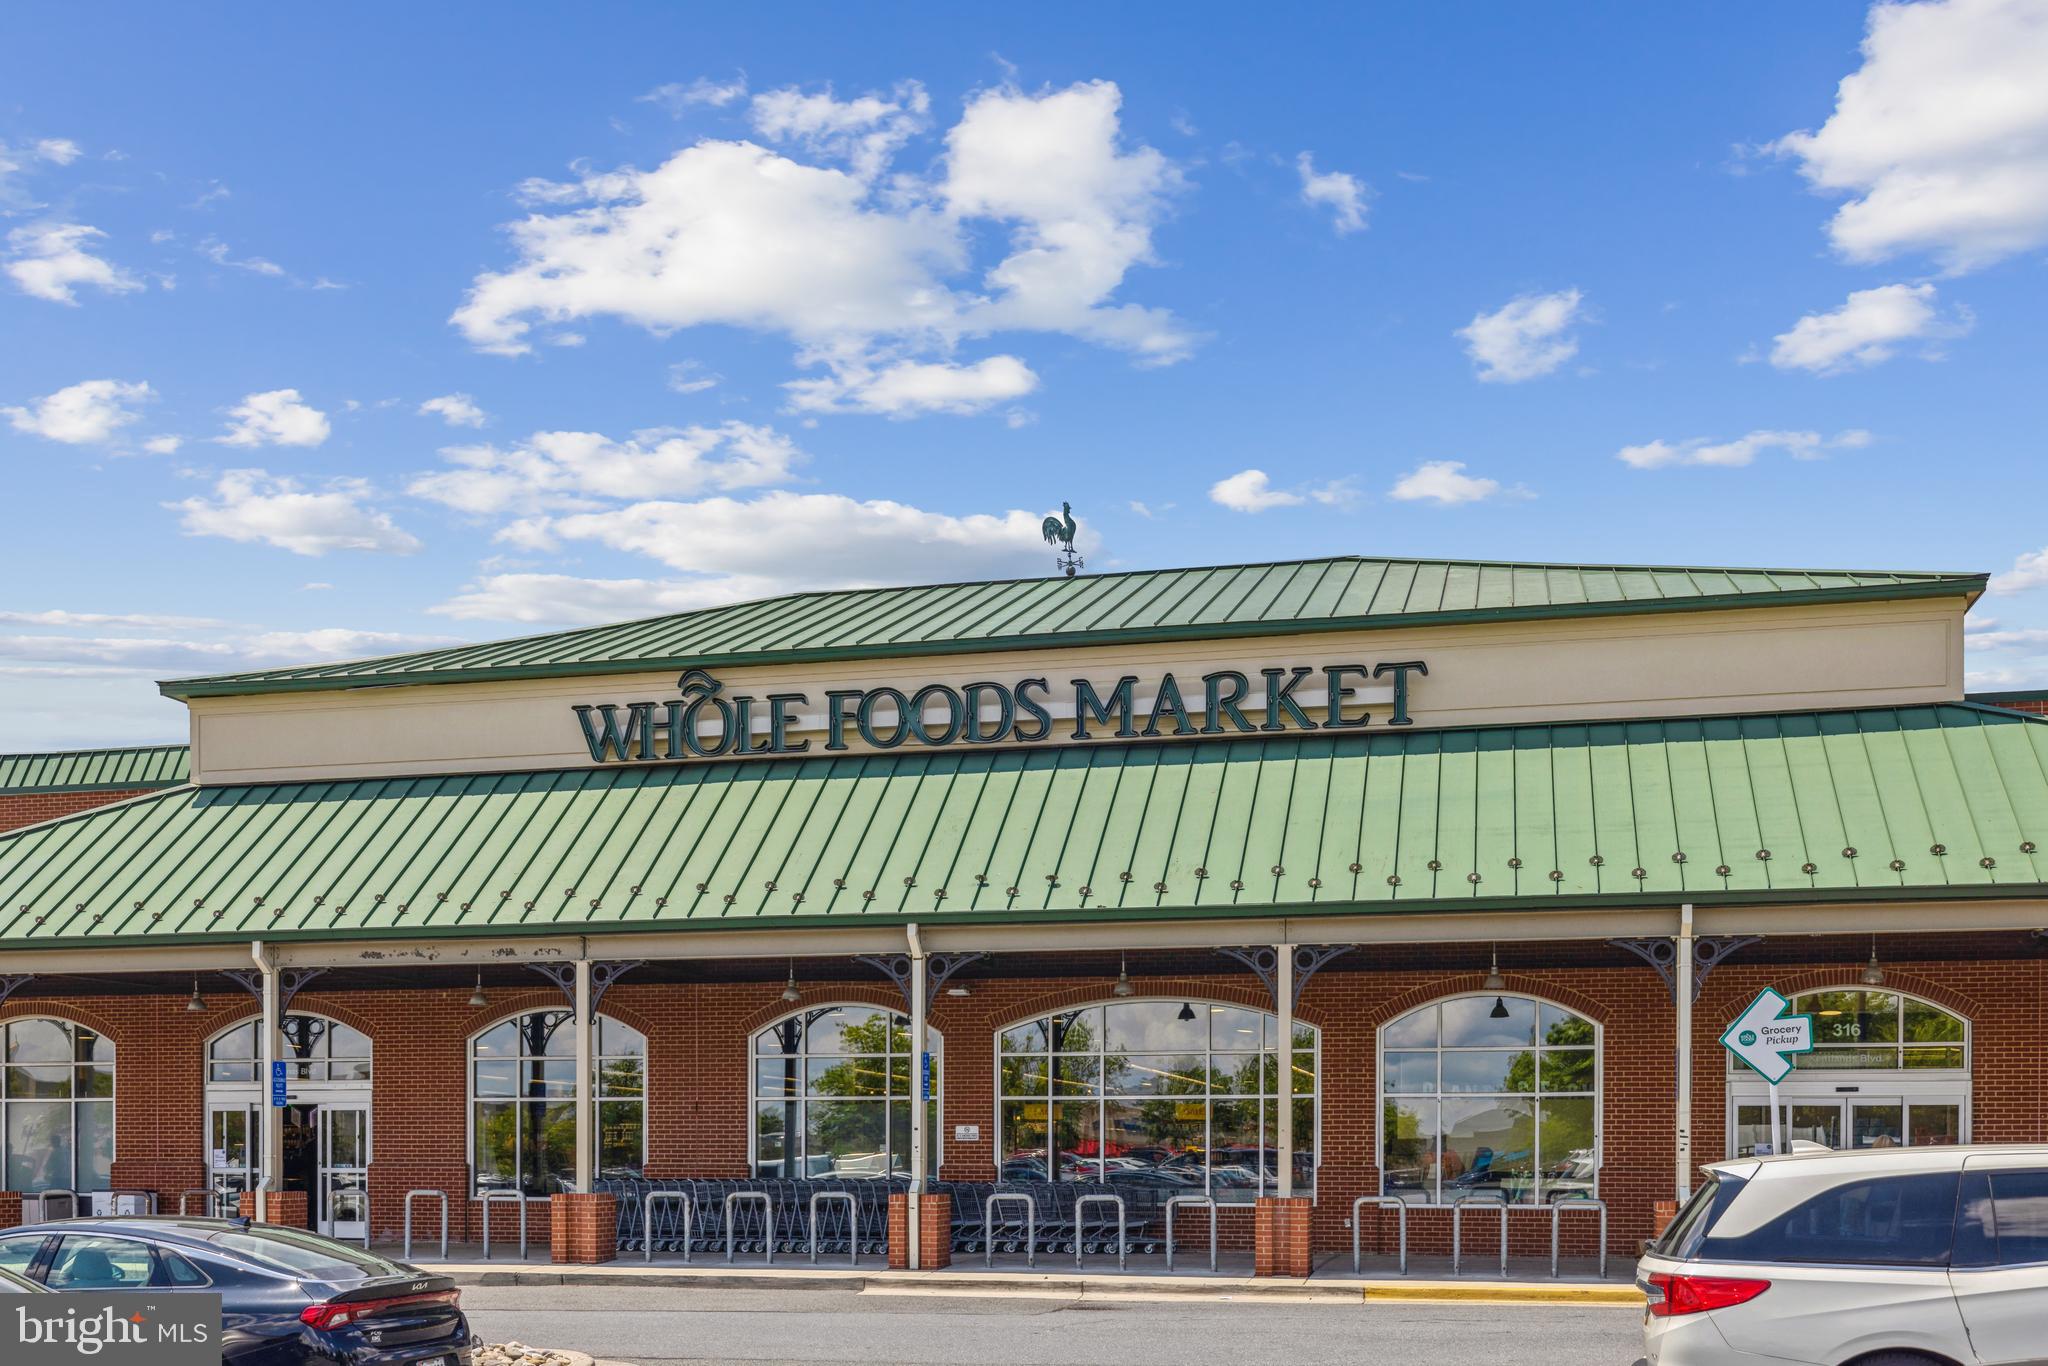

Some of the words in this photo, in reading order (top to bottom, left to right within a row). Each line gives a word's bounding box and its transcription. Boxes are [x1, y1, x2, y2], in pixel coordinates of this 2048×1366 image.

[571, 669, 811, 763] WHOLE
[825, 677, 1052, 750] FOODS
[1070, 661, 1429, 740] MARKET
[1761, 1026, 1802, 1035] Grocery
[1832, 1023, 1861, 1037] 316
[1766, 1035, 1799, 1045] Pickup
